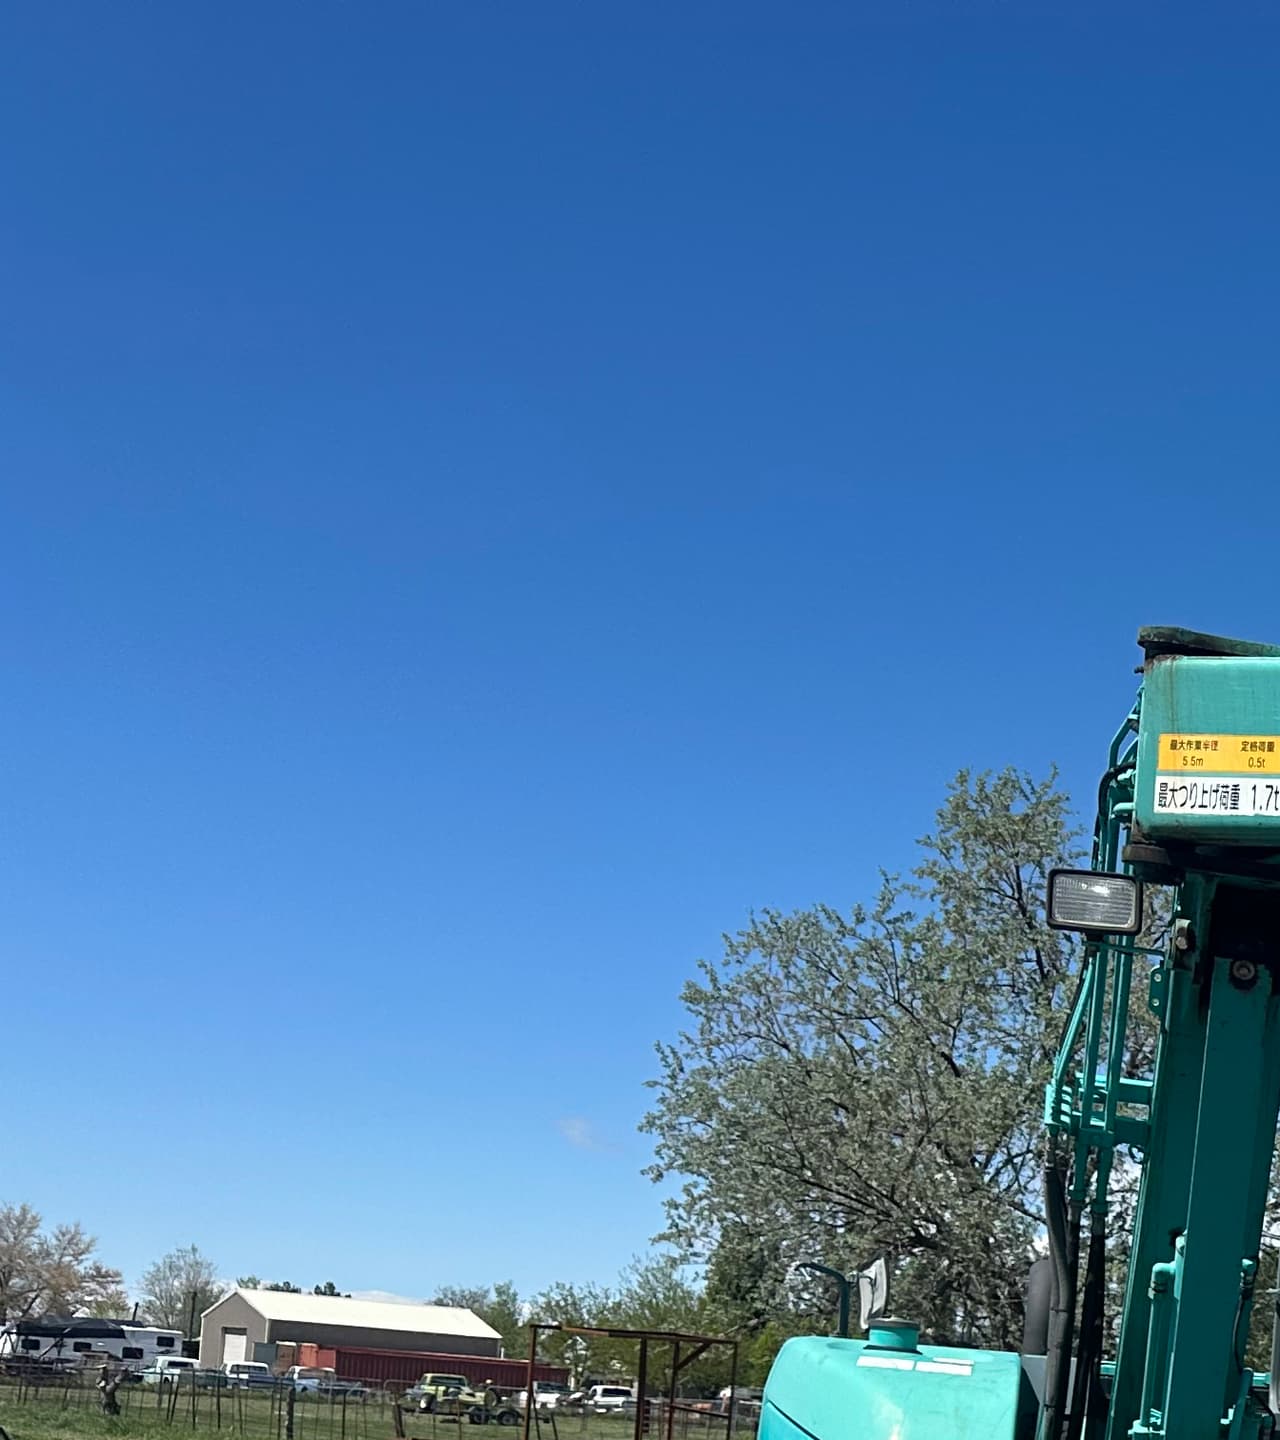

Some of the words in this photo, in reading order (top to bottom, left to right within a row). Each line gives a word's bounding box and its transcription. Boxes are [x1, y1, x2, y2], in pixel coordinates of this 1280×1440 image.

[1182, 755, 1204, 767] 55m
[1248, 757, 1266, 769] 0.5t
[1158, 782, 1240, 810] 最大つり上げ荷重
[1251, 783, 1280, 811] 1.7t
